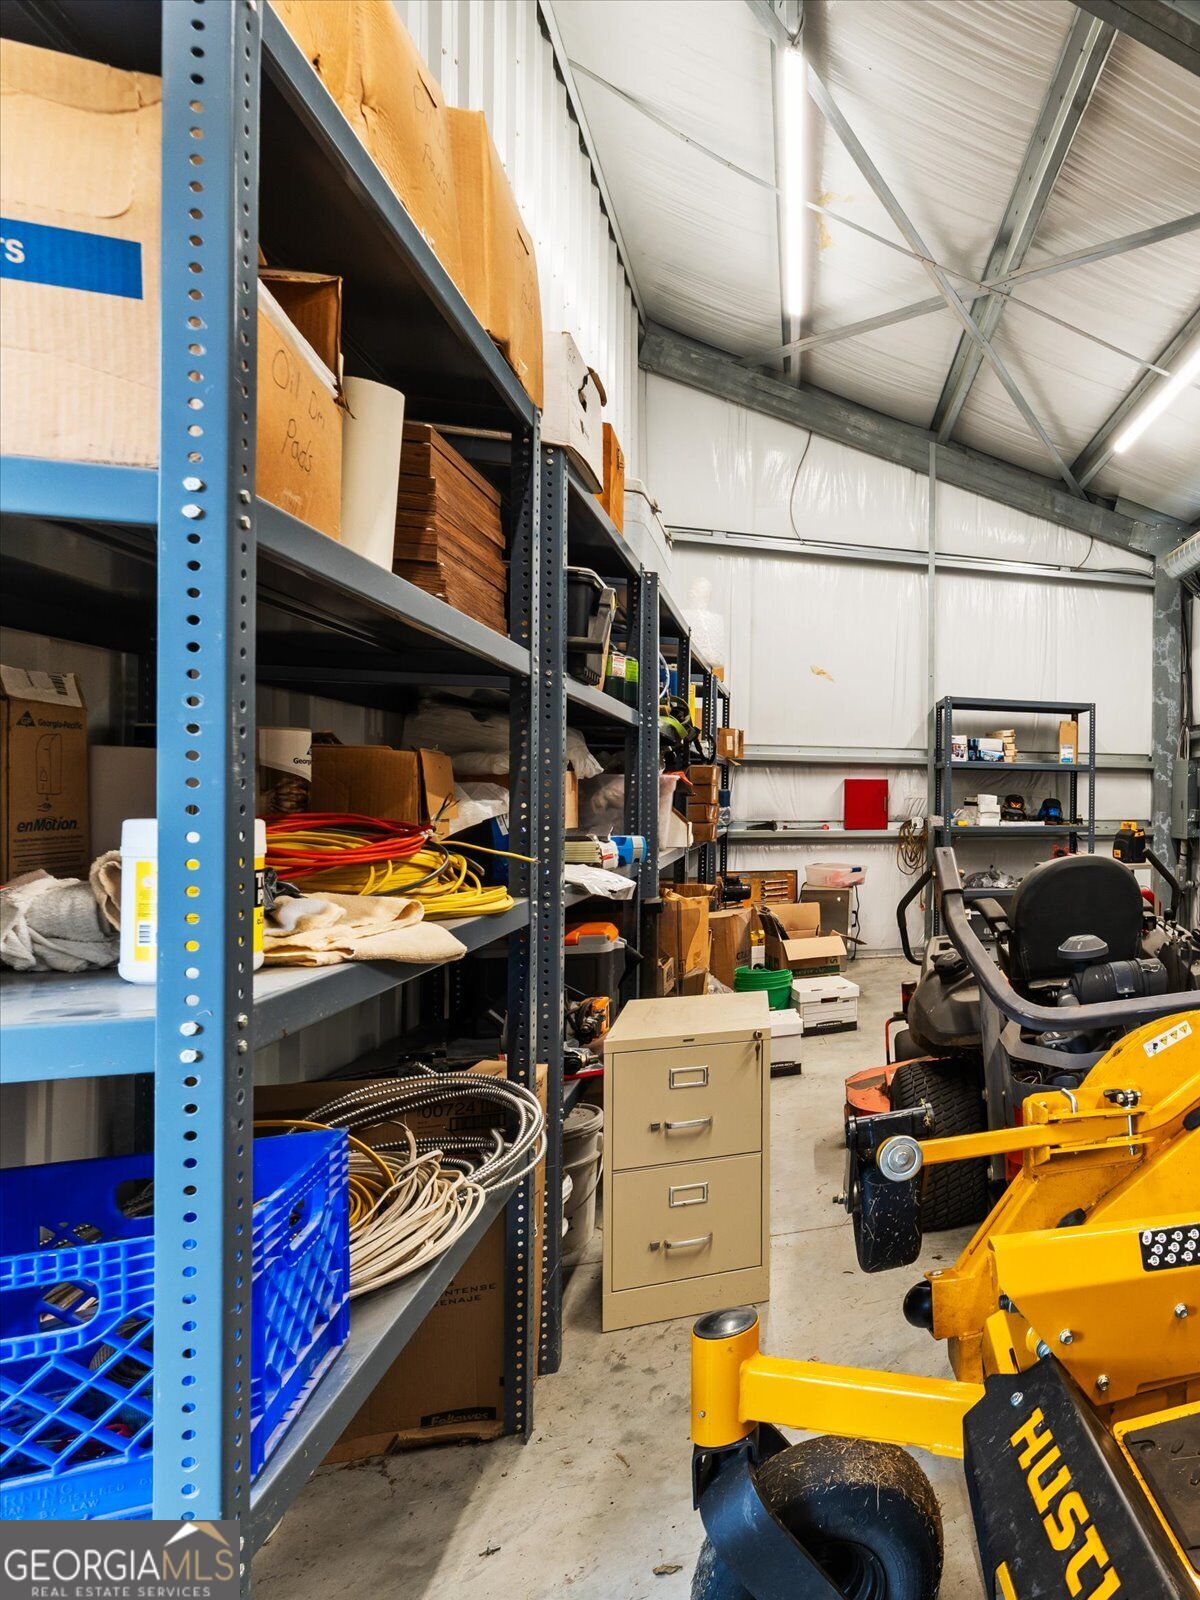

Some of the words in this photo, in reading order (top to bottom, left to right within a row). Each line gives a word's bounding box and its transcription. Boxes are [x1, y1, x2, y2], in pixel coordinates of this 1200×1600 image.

[272, 349, 300, 400] Oil
[281, 418, 314, 473] Pads
[17, 816, 78, 833] enMotion
